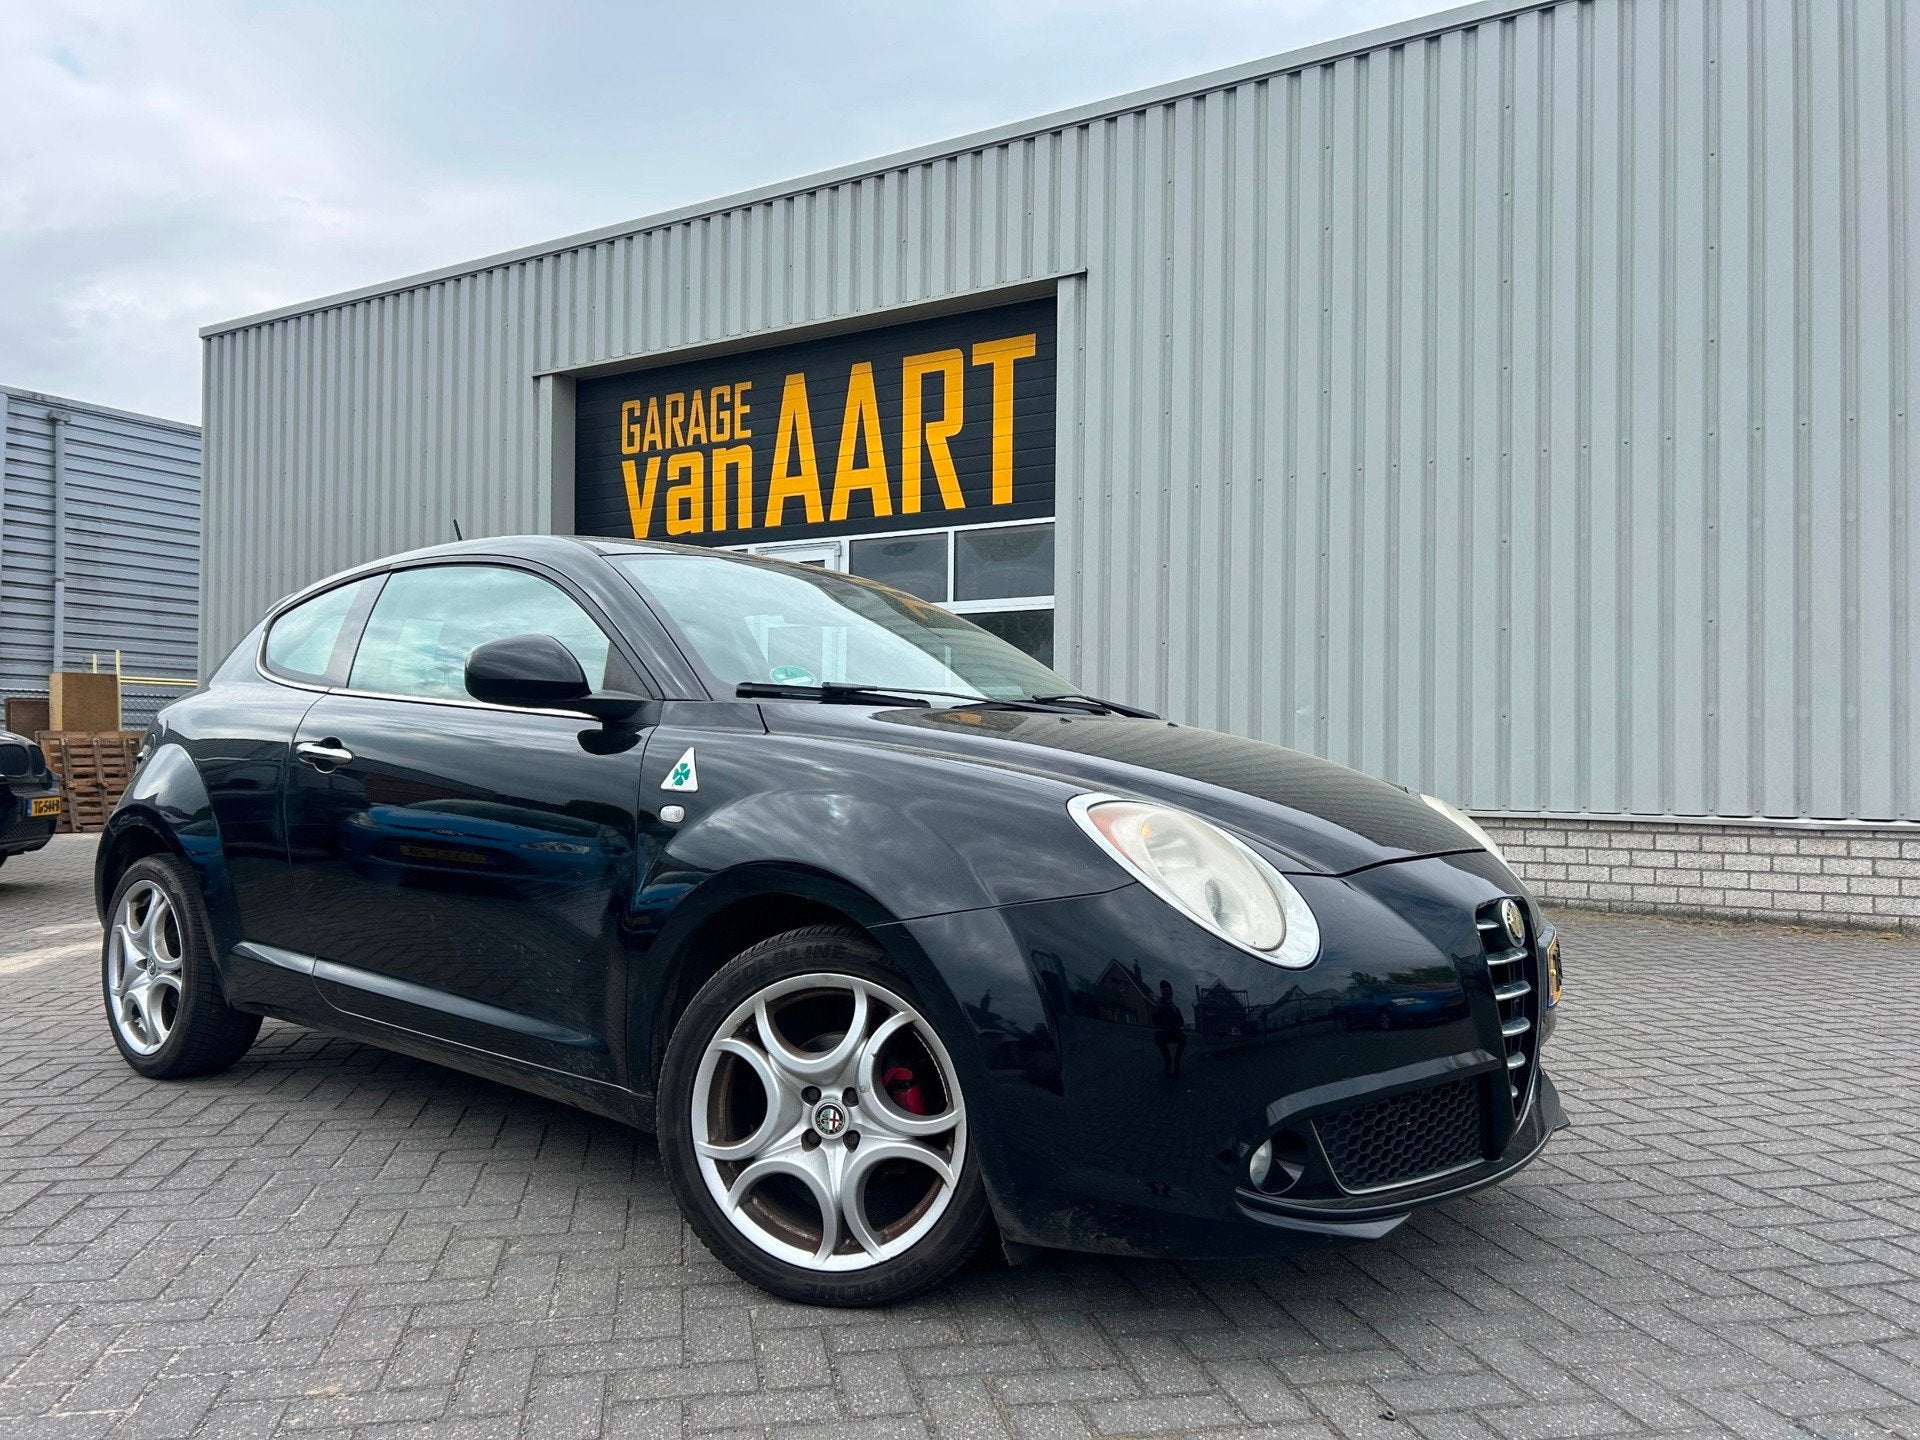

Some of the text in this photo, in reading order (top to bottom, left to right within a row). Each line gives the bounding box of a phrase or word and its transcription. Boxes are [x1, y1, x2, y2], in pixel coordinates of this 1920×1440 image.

[620, 381, 753, 455] GARAGE
[621, 333, 1037, 538] van AART
